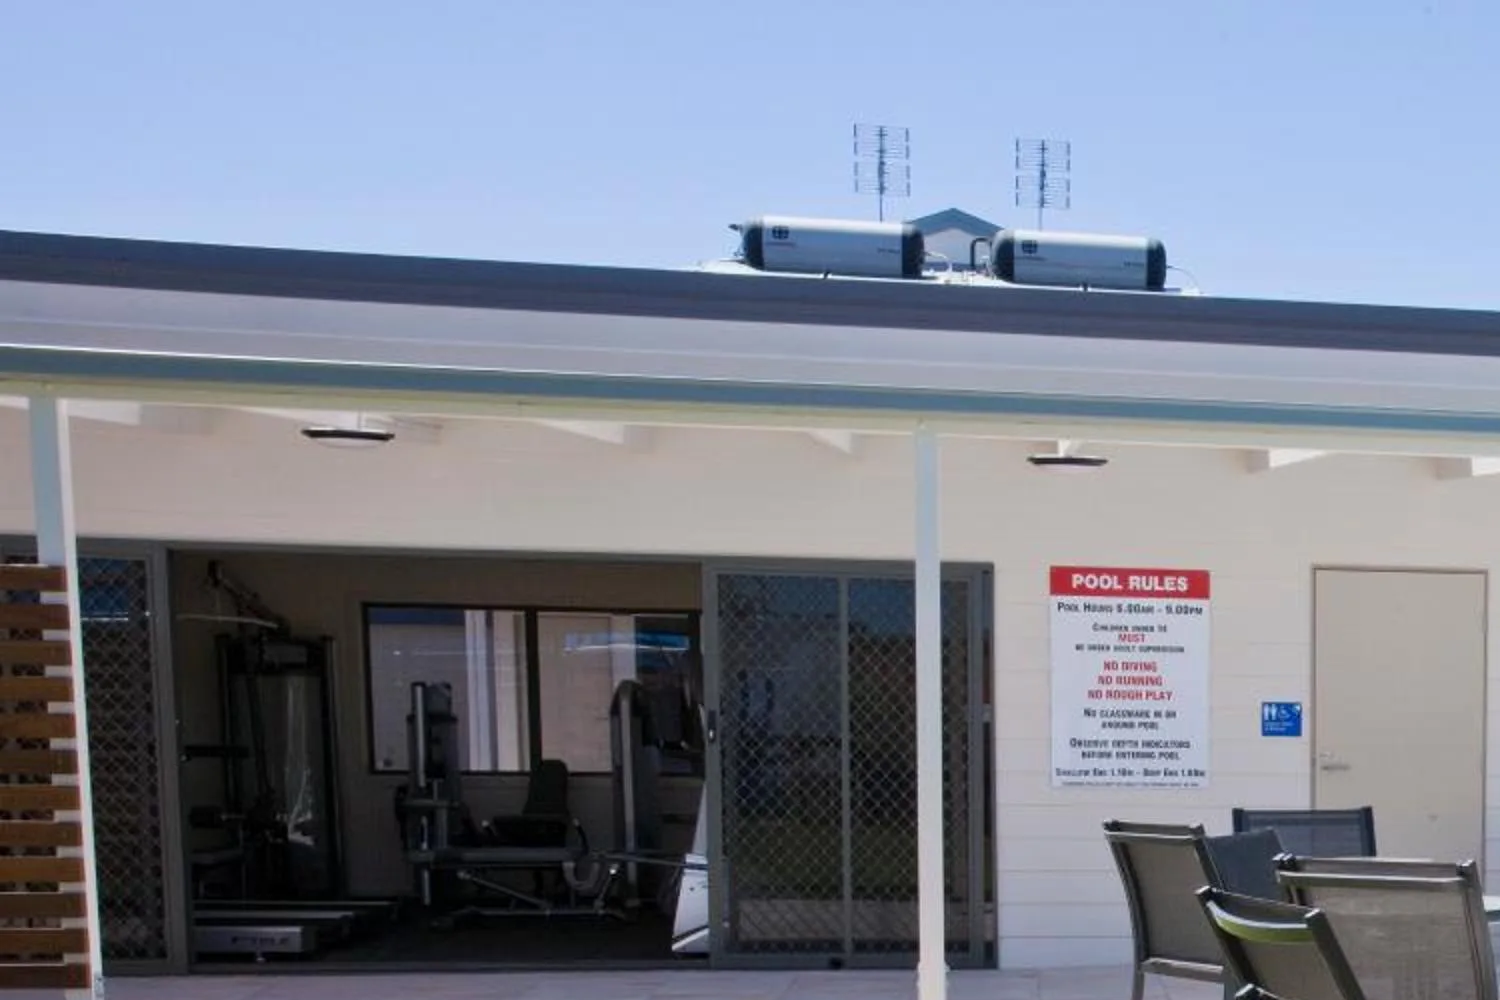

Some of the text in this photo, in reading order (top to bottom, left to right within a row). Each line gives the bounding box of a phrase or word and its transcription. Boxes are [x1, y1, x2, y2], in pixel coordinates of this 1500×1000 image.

[1071, 573, 1189, 592] POOL RULES
[1118, 633, 1146, 643] MUST
[1103, 661, 1158, 672] NO DIVING
[1098, 675, 1163, 686] NO RUNNING
[1088, 690, 1173, 701] NO ROUGH PLAY
